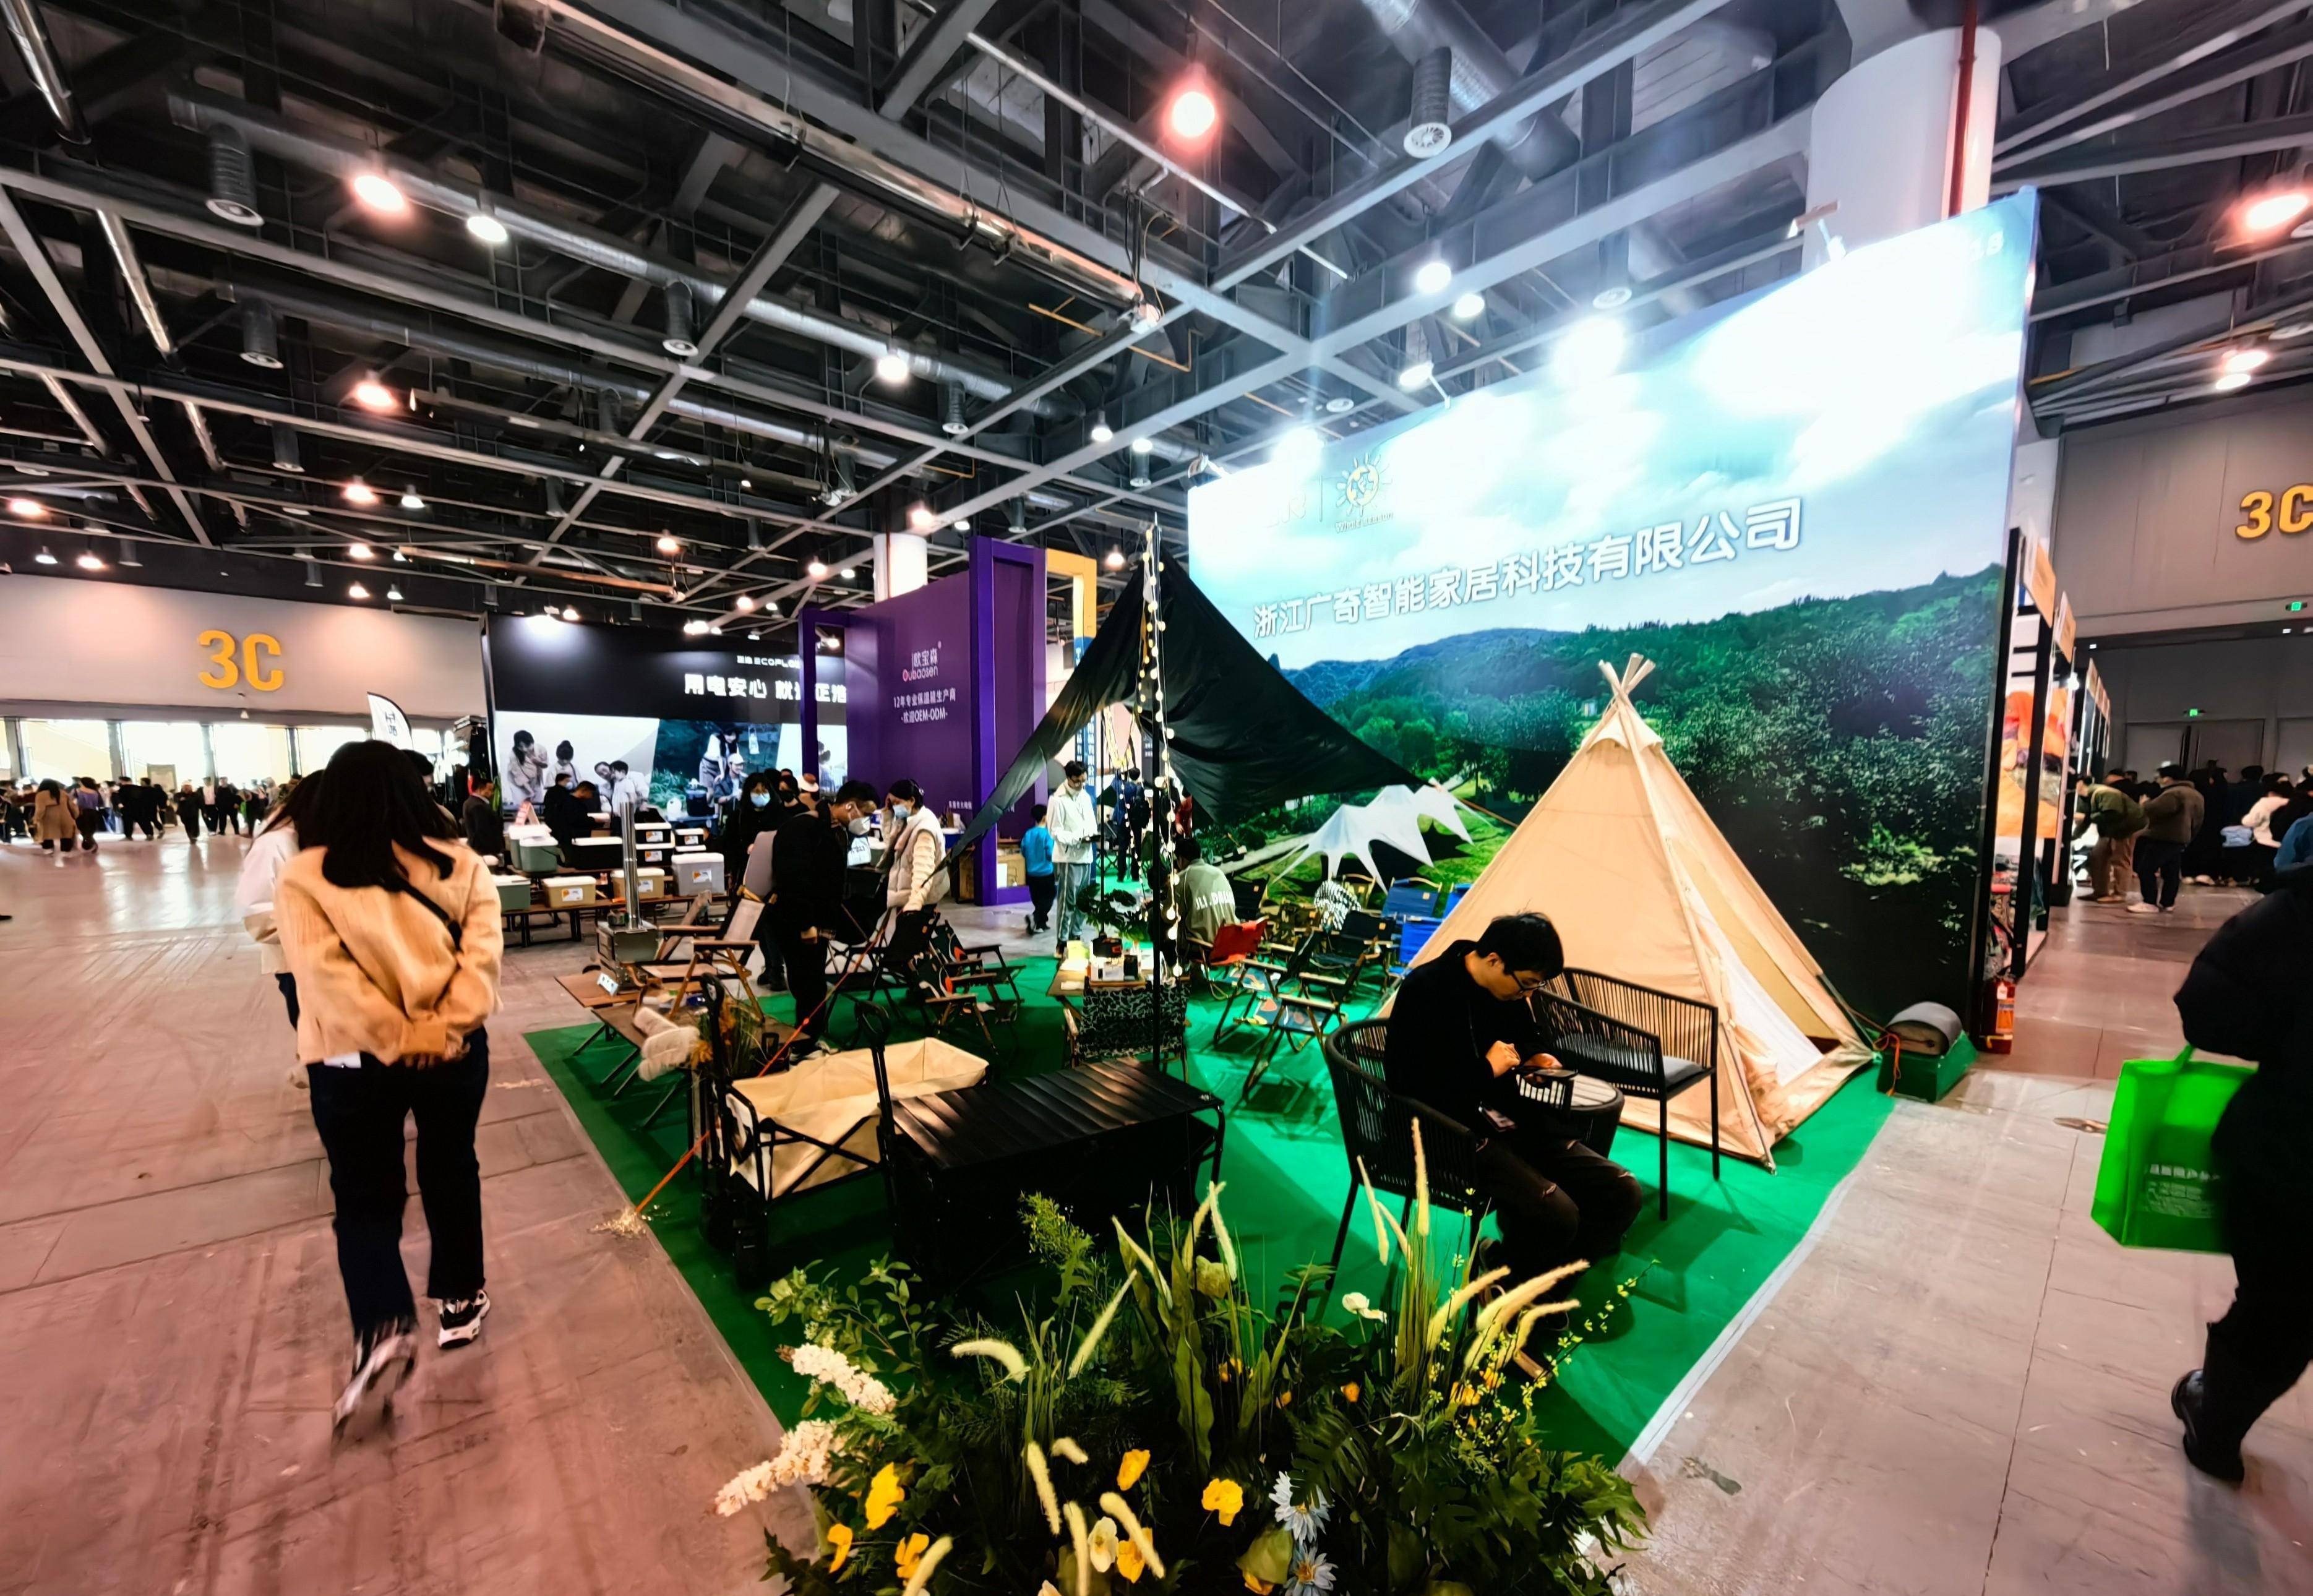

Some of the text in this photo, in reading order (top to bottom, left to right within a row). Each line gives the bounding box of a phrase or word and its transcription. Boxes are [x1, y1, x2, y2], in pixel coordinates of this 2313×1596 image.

[2235, 483, 2313, 539] 3C
[1253, 497, 1803, 639] 浙江广奇智能家居科技有限公司
[197, 629, 285, 692] 3C
[684, 673, 767, 699] 用电安心
